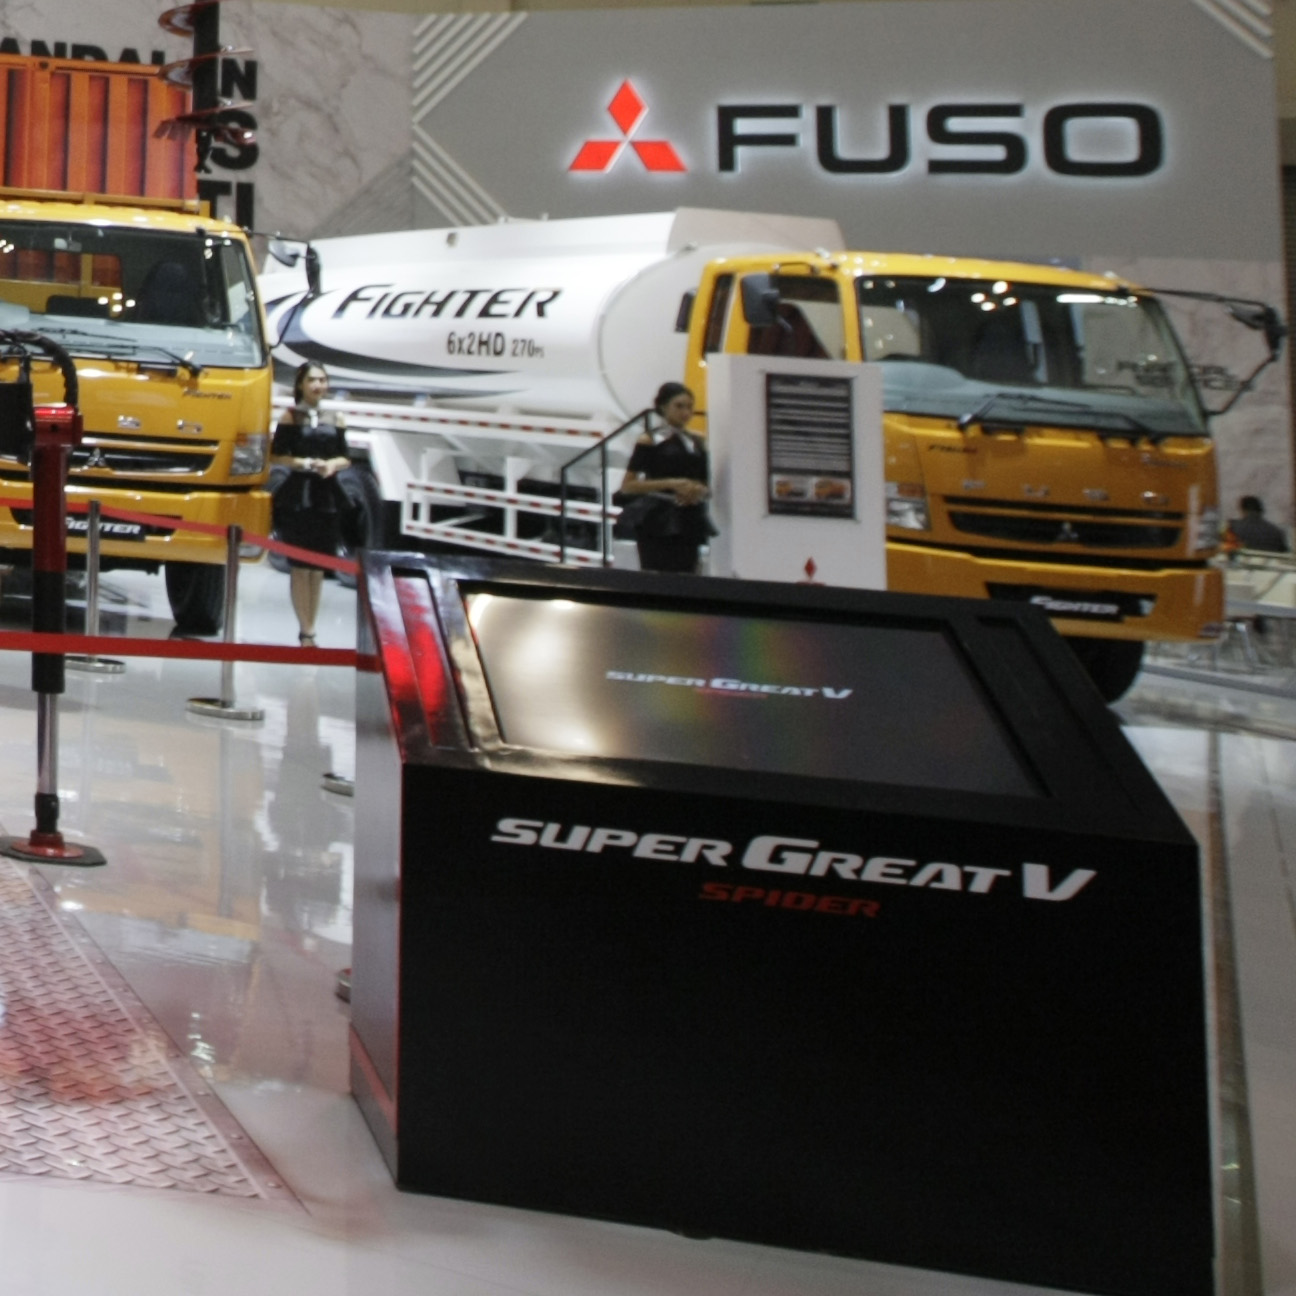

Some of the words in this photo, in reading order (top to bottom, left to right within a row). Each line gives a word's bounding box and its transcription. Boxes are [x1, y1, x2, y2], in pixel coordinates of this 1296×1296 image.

[717, 102, 1164, 178] FUSO
[331, 283, 563, 320] FIGHTER
[446, 331, 506, 358] 6x2HD
[605, 670, 707, 688] SUPER
[709, 677, 820, 698] GREAT
[821, 686, 854, 700] V
[490, 817, 733, 866] SUPER
[740, 834, 1011, 894] GREAT
[1021, 862, 1097, 902] V
[698, 881, 881, 919] SPIDER
